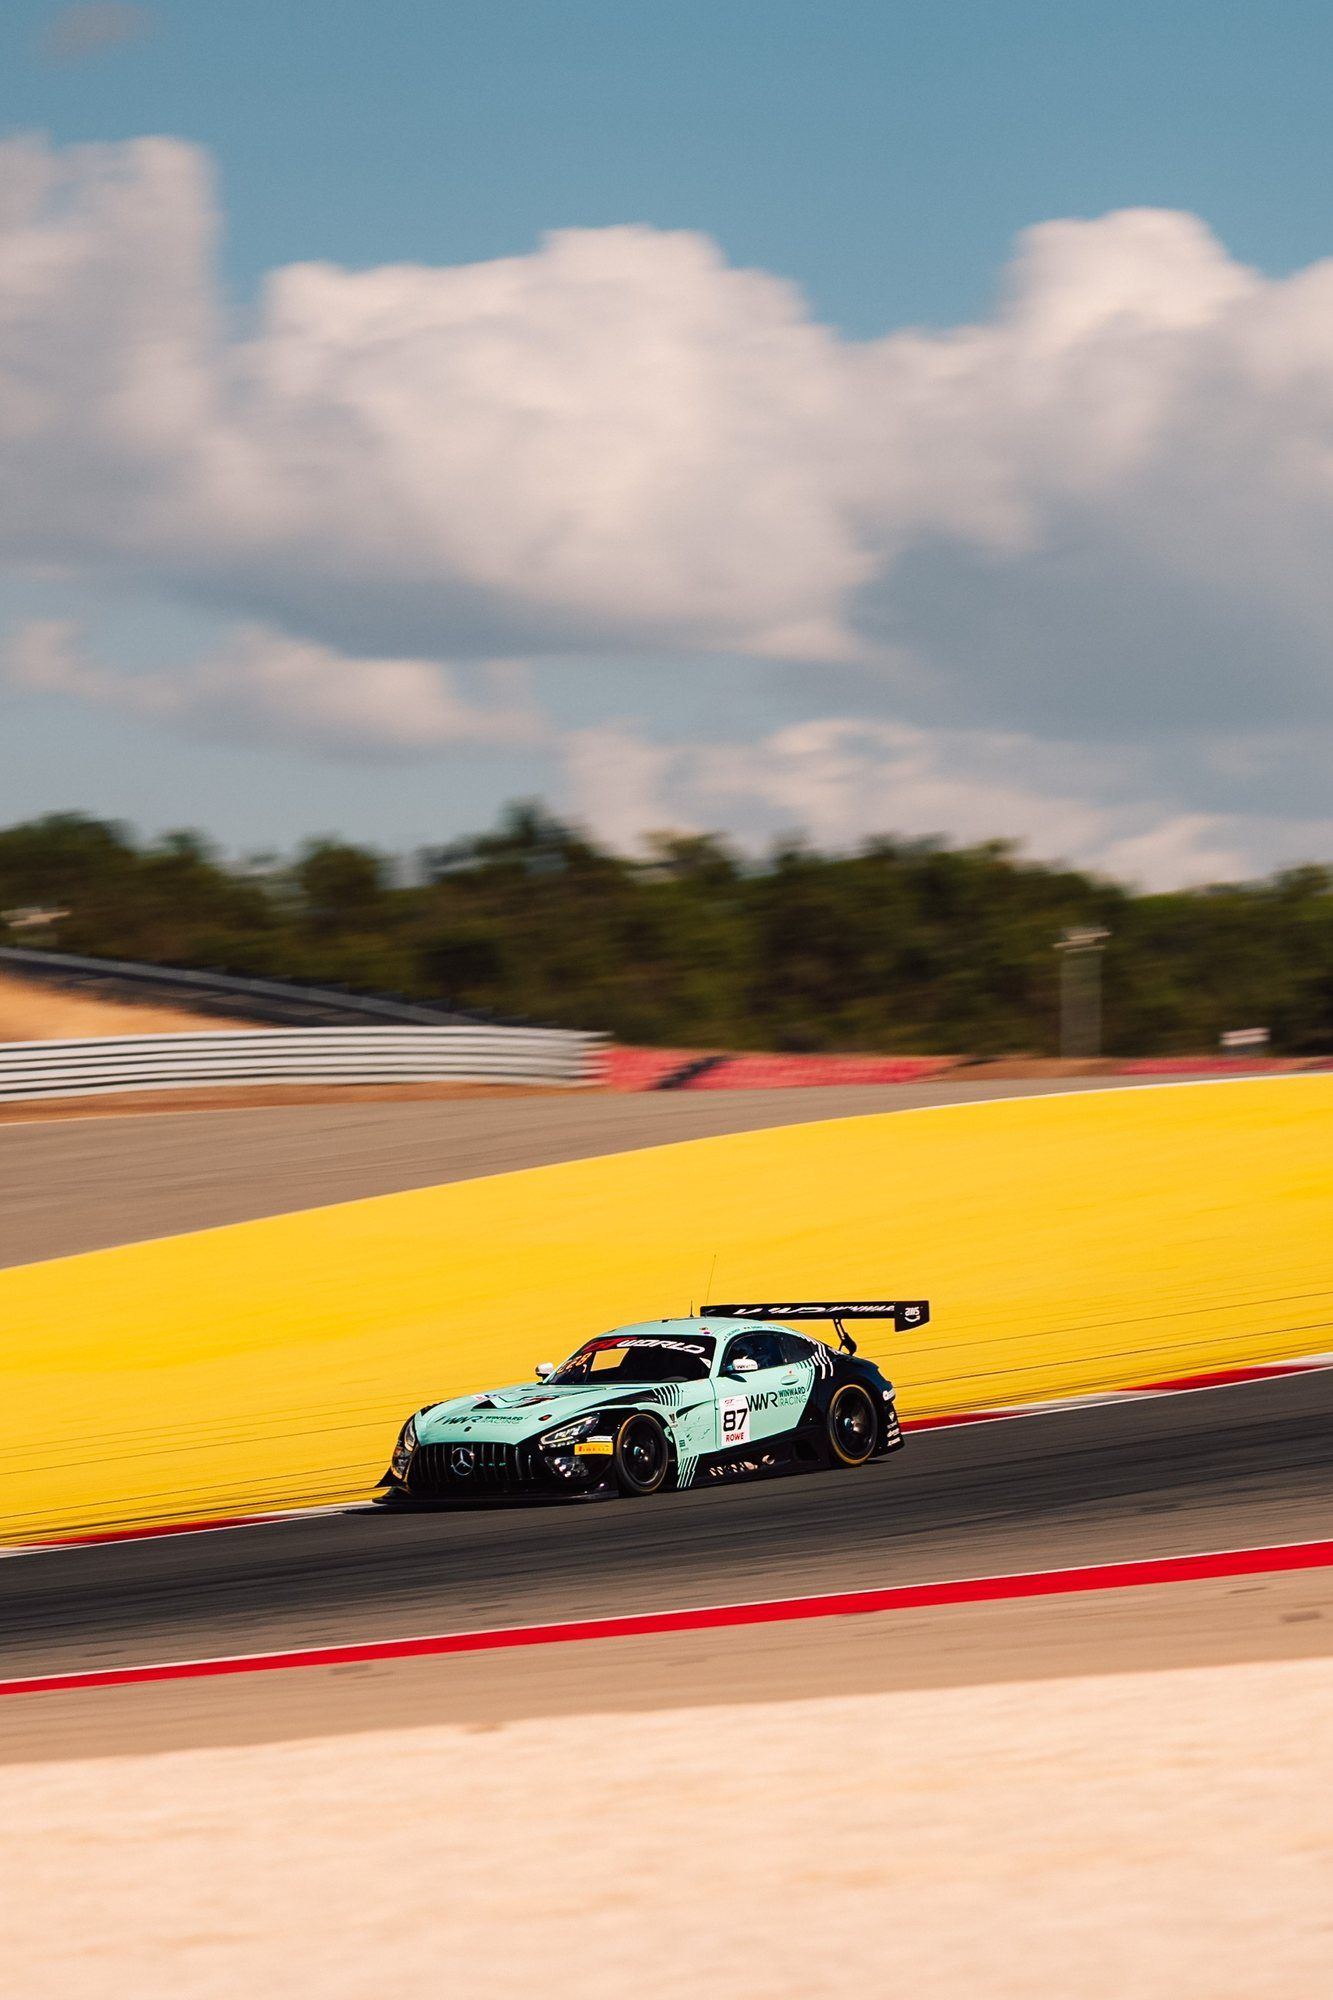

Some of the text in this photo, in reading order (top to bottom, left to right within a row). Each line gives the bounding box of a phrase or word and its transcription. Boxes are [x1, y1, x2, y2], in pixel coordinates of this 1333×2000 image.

[616, 1338, 706, 1355] WORLD
[778, 1386, 806, 1398] WINWARD
[780, 1395, 807, 1406] RACING
[723, 1407, 747, 1432] 87
[725, 1432, 744, 1442] ROWE
